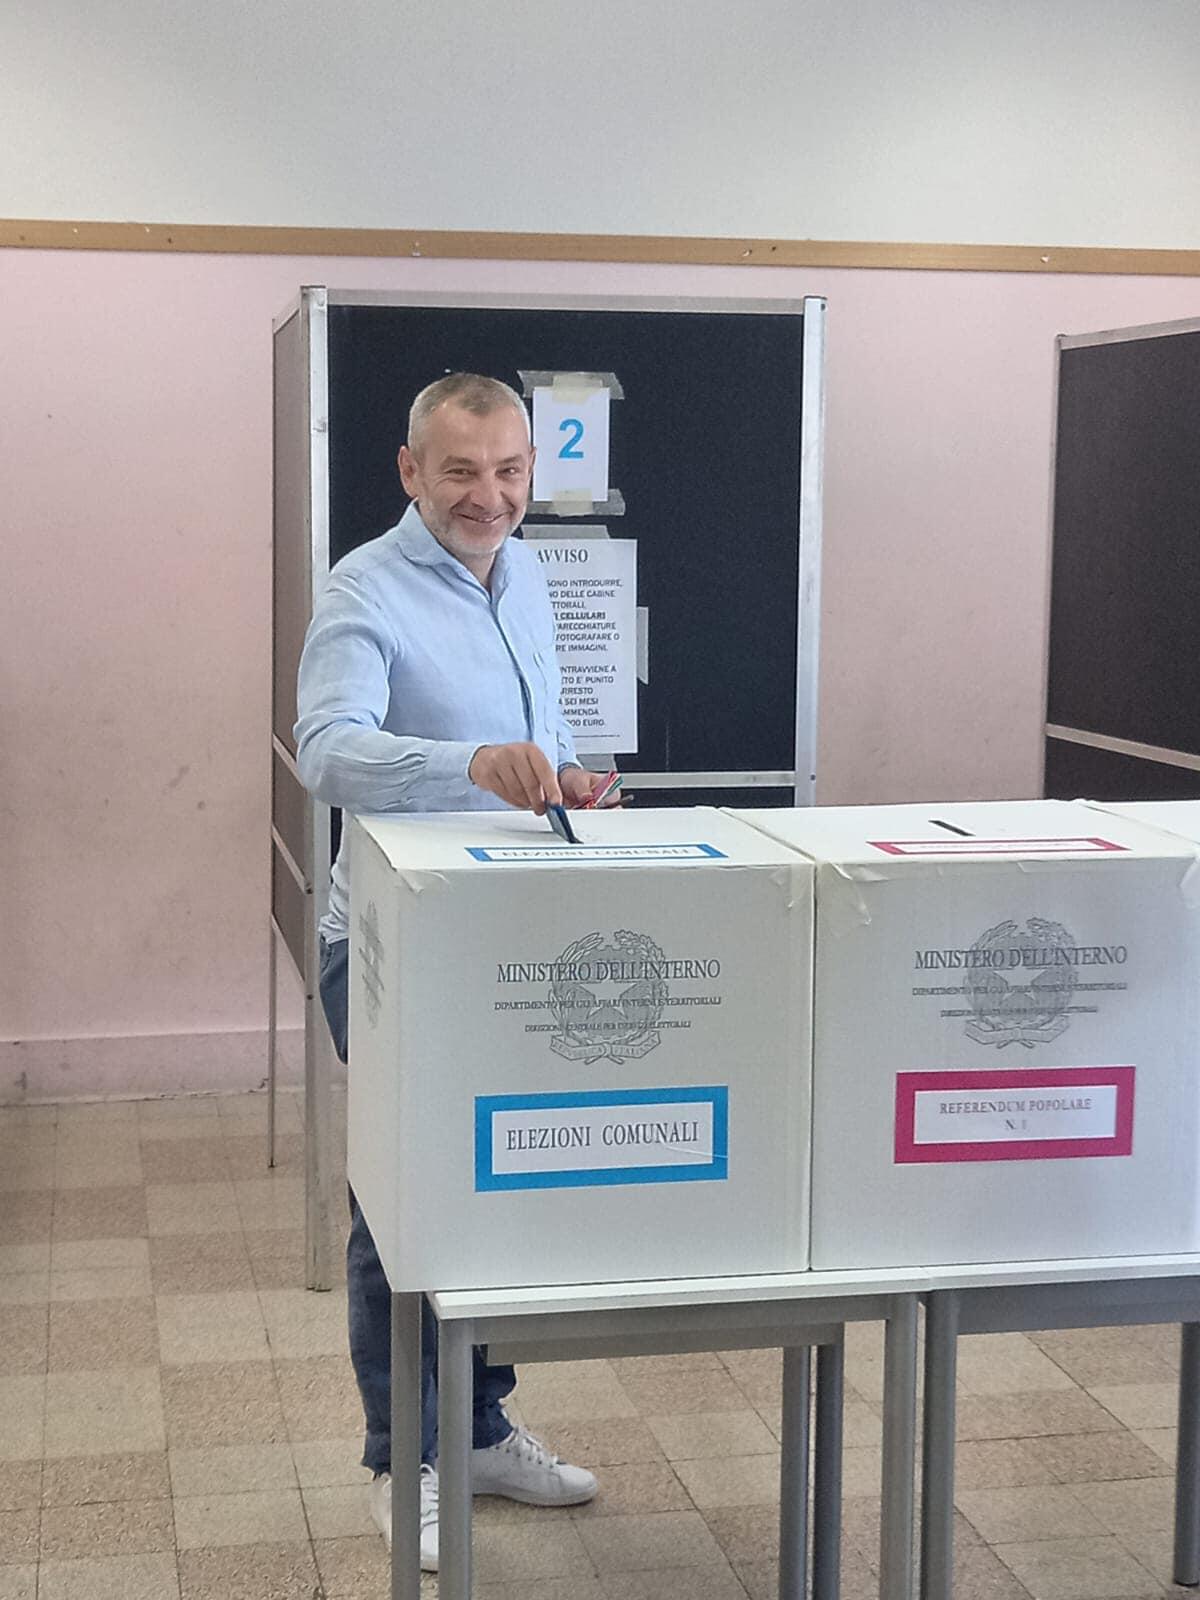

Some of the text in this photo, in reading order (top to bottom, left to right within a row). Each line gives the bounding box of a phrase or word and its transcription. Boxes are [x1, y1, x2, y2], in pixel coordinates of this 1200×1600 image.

[558, 418, 585, 459] 2
[537, 549, 588, 563] AVVISO
[546, 579, 568, 587] SONO
[557, 622, 616, 630] ARECCHIATURE
[560, 665, 617, 673] NTRAVVIENE A
[585, 676, 614, 684] PUNITO
[914, 946, 1128, 969] MINISTERO DELL'INTERNO
[497, 959, 721, 983] MINISTERO DELL'INTERNO
[940, 1098, 1092, 1114] REFERENDUM POPOLARE
[507, 1122, 698, 1150] ELEZIONI COMUNALI
